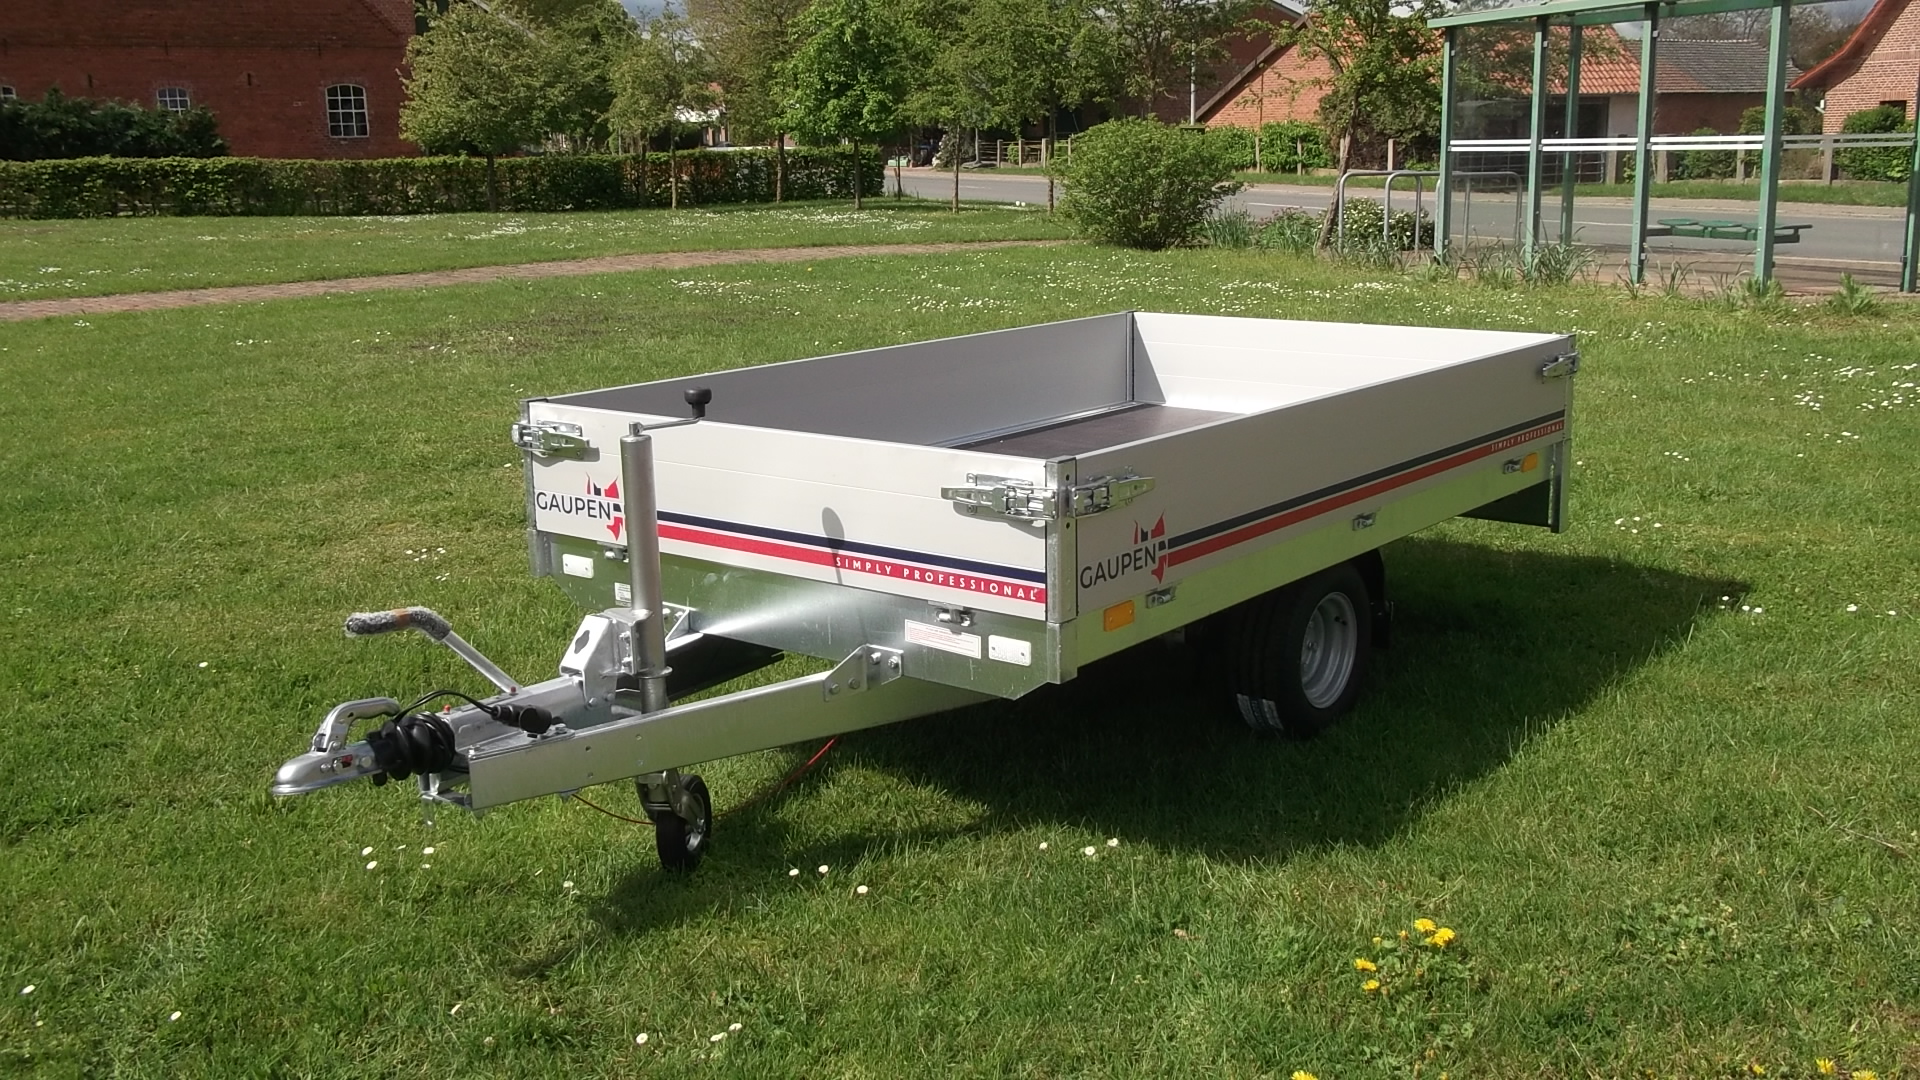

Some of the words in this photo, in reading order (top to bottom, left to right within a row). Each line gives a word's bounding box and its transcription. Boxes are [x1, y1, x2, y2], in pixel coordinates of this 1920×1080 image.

[1491, 440, 1514, 452] SIMPLY
[1517, 422, 1563, 442] PROFESSIONAL
[536, 491, 611, 520] GAUPEN
[836, 556, 892, 575] SIMPLY
[903, 569, 1036, 600] PROFESSIONAL
[1080, 543, 1156, 589] GAUPEN
